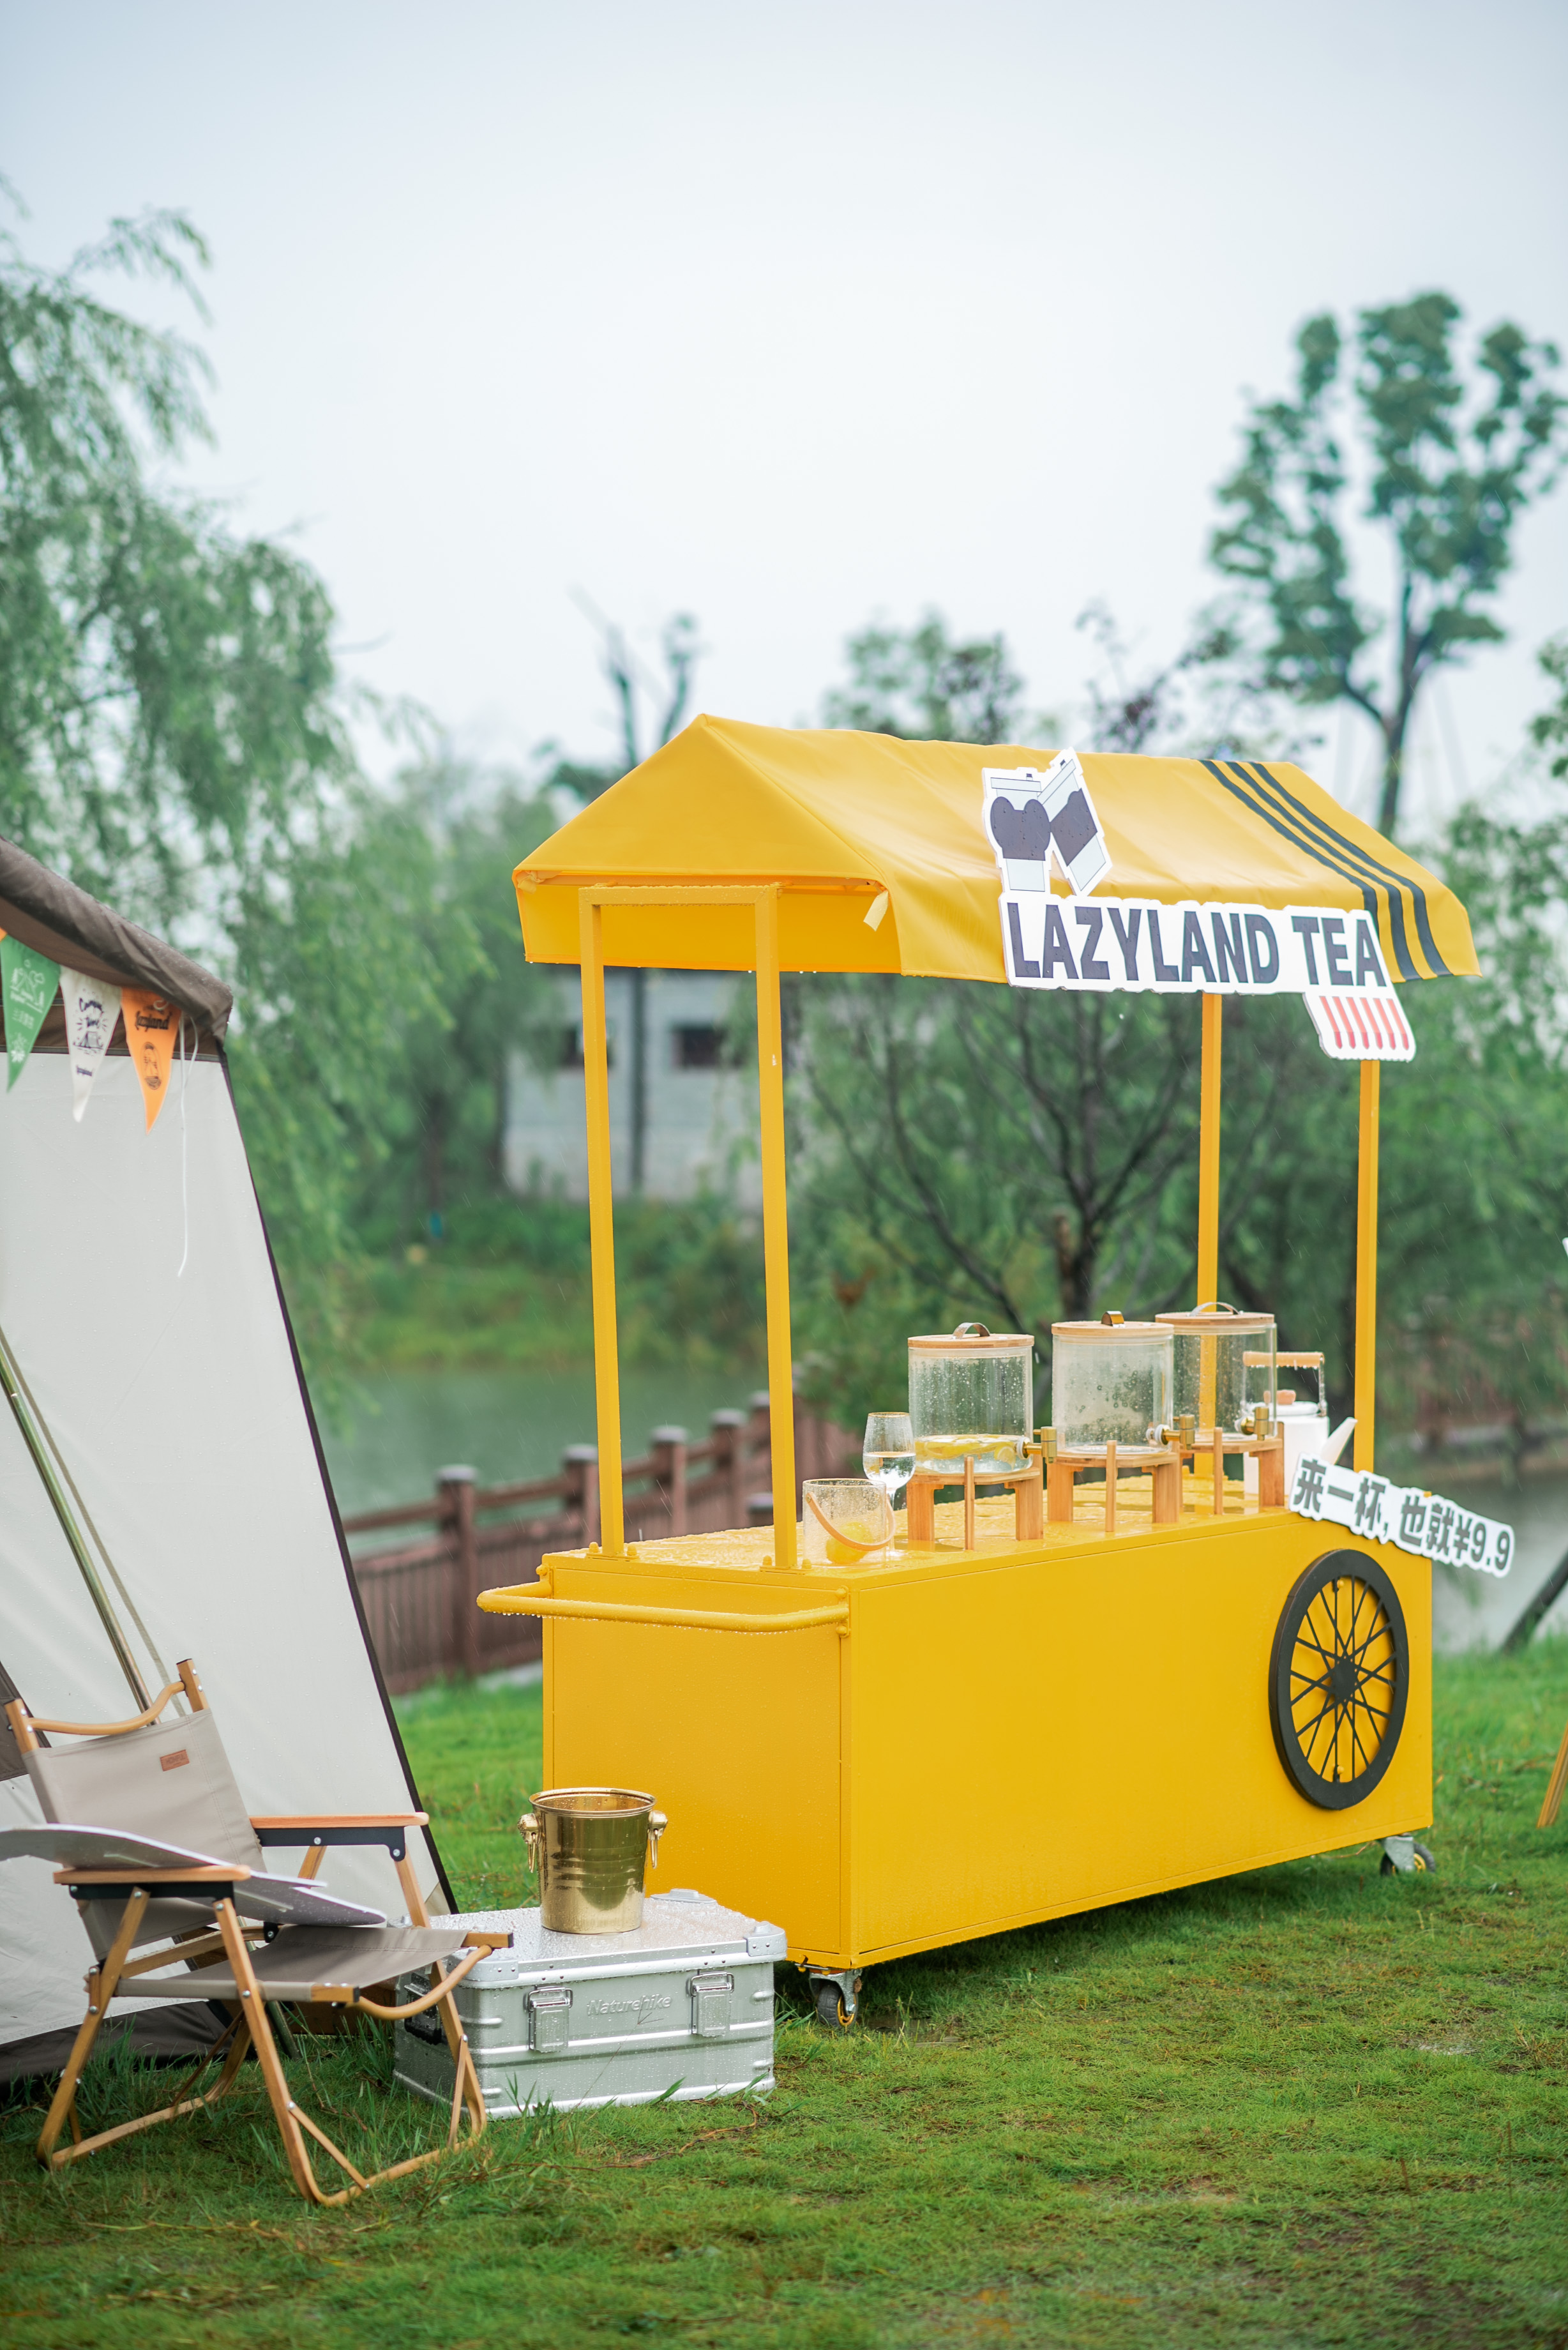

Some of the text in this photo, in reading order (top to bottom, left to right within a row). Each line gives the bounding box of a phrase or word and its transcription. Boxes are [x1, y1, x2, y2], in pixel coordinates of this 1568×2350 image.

[1007, 902, 1387, 987] LAZYLAND TEA
[587, 1994, 671, 2015] Naturehike
